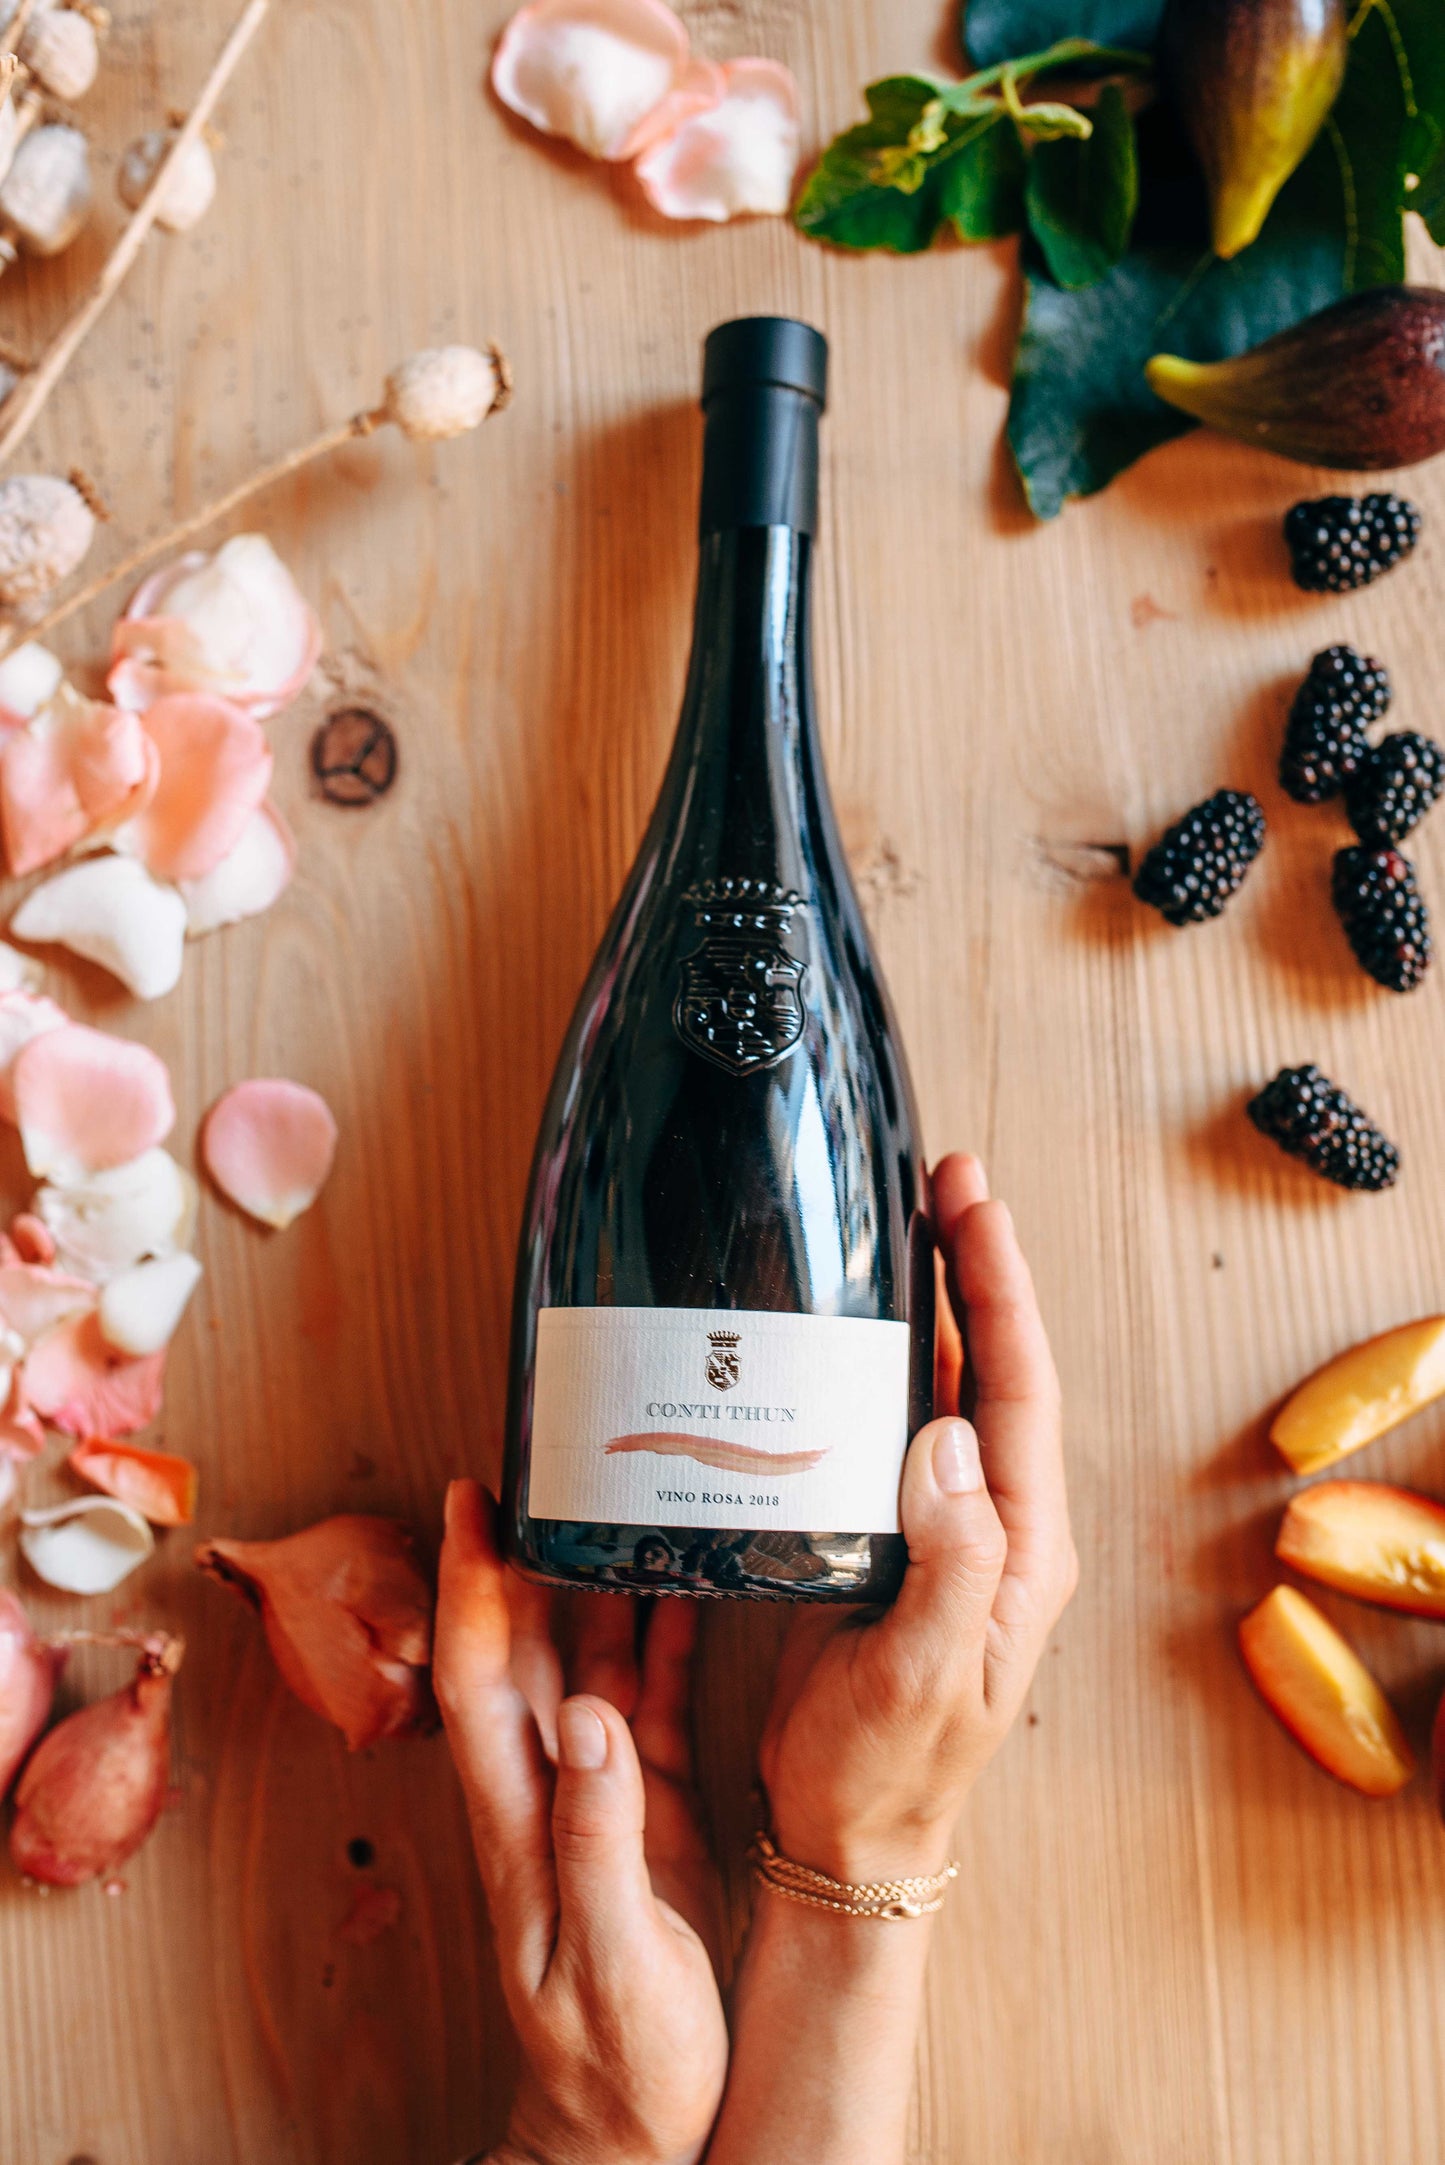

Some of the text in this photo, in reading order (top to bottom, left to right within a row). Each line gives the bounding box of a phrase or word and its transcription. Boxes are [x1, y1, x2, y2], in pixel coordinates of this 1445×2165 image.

[646, 1402, 796, 1422] CONTI THUN
[656, 1490, 780, 1506] VINO ROSA 2018
